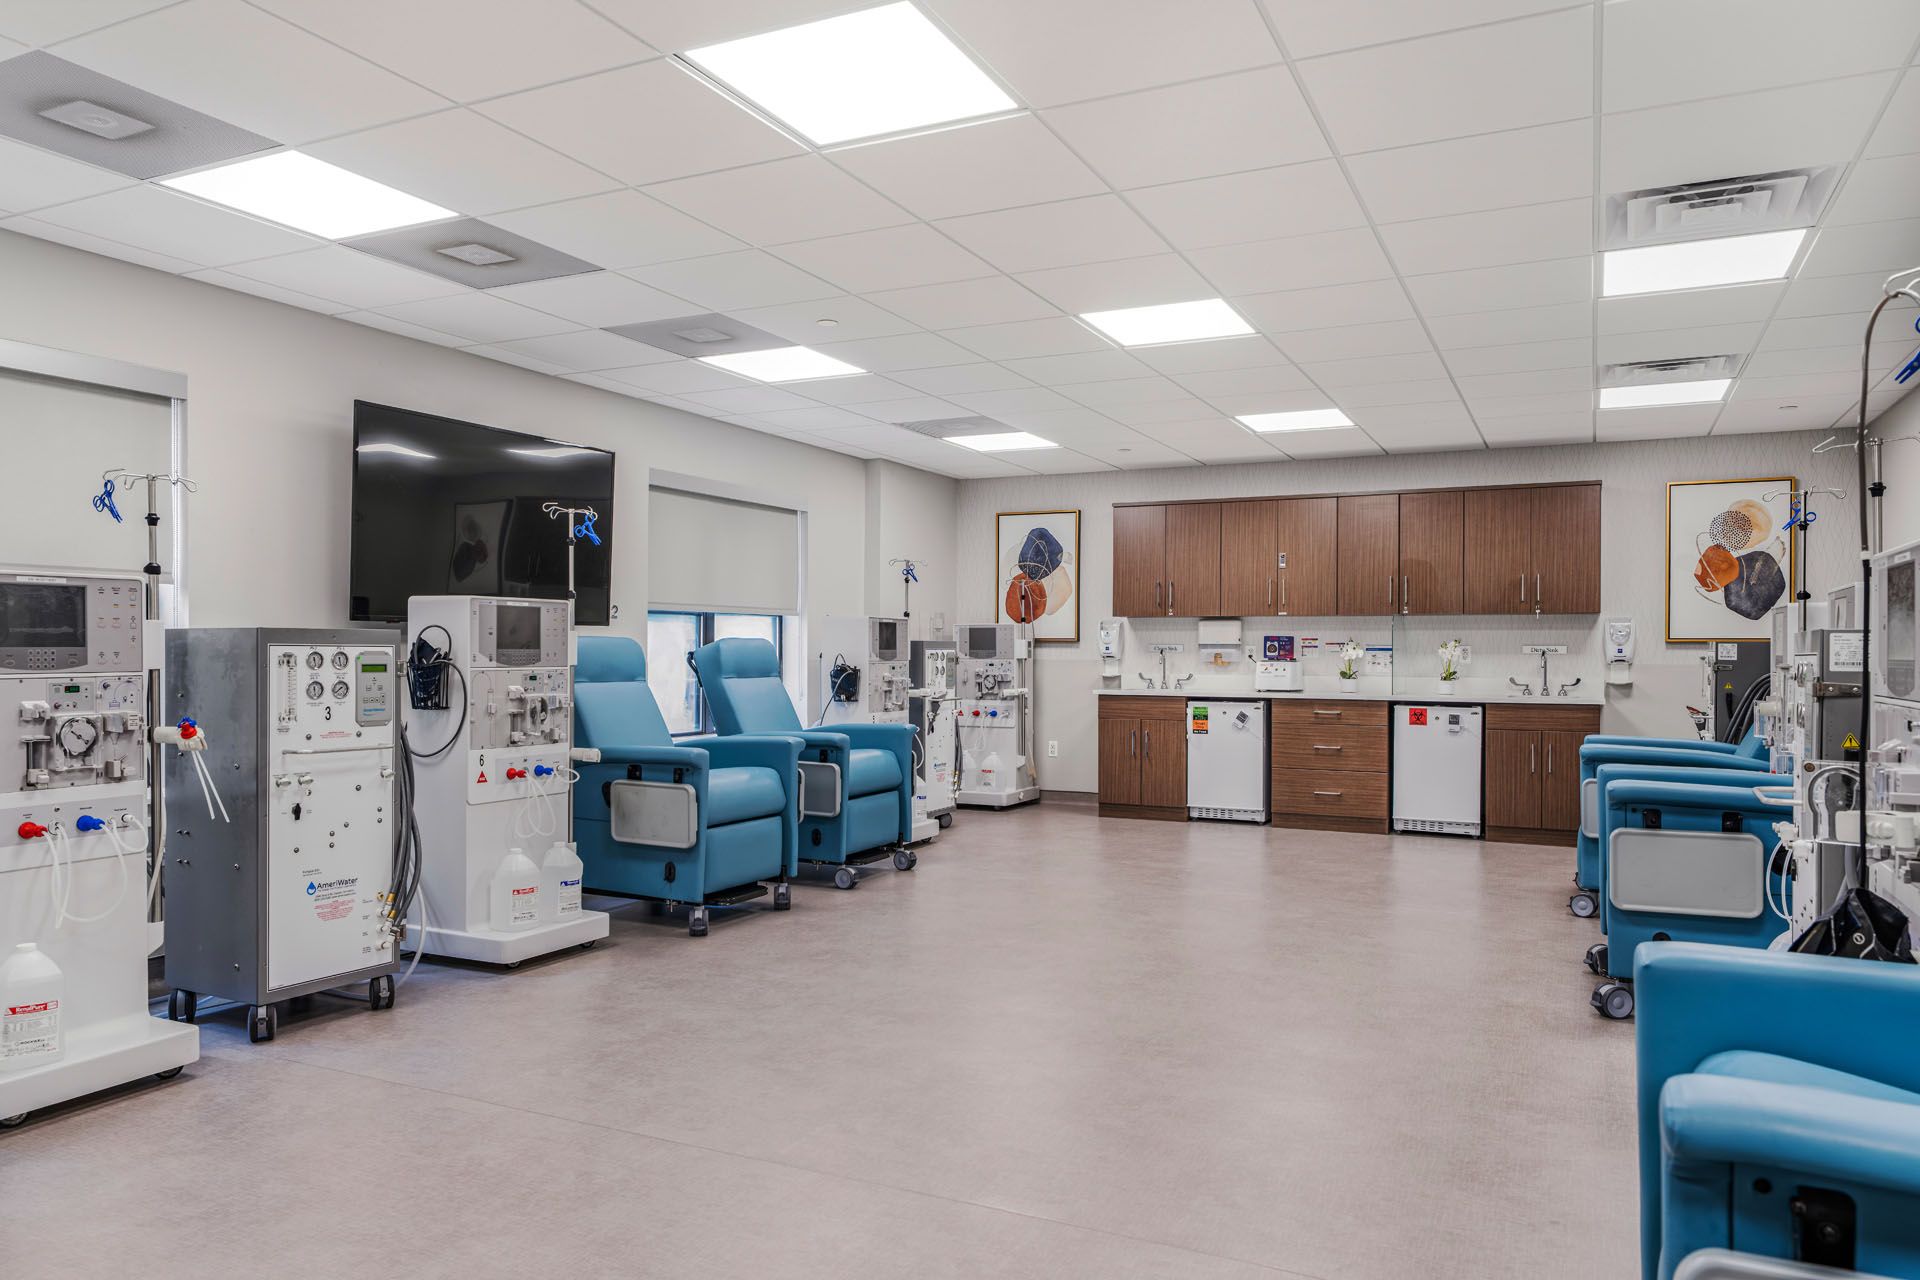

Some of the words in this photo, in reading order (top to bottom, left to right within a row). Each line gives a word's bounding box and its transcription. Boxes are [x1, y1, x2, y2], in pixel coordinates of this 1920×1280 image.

[610, 604, 619, 619] 2
[324, 706, 332, 721] 3
[479, 754, 485, 767] 6
[316, 877, 359, 890] AmeriWater
